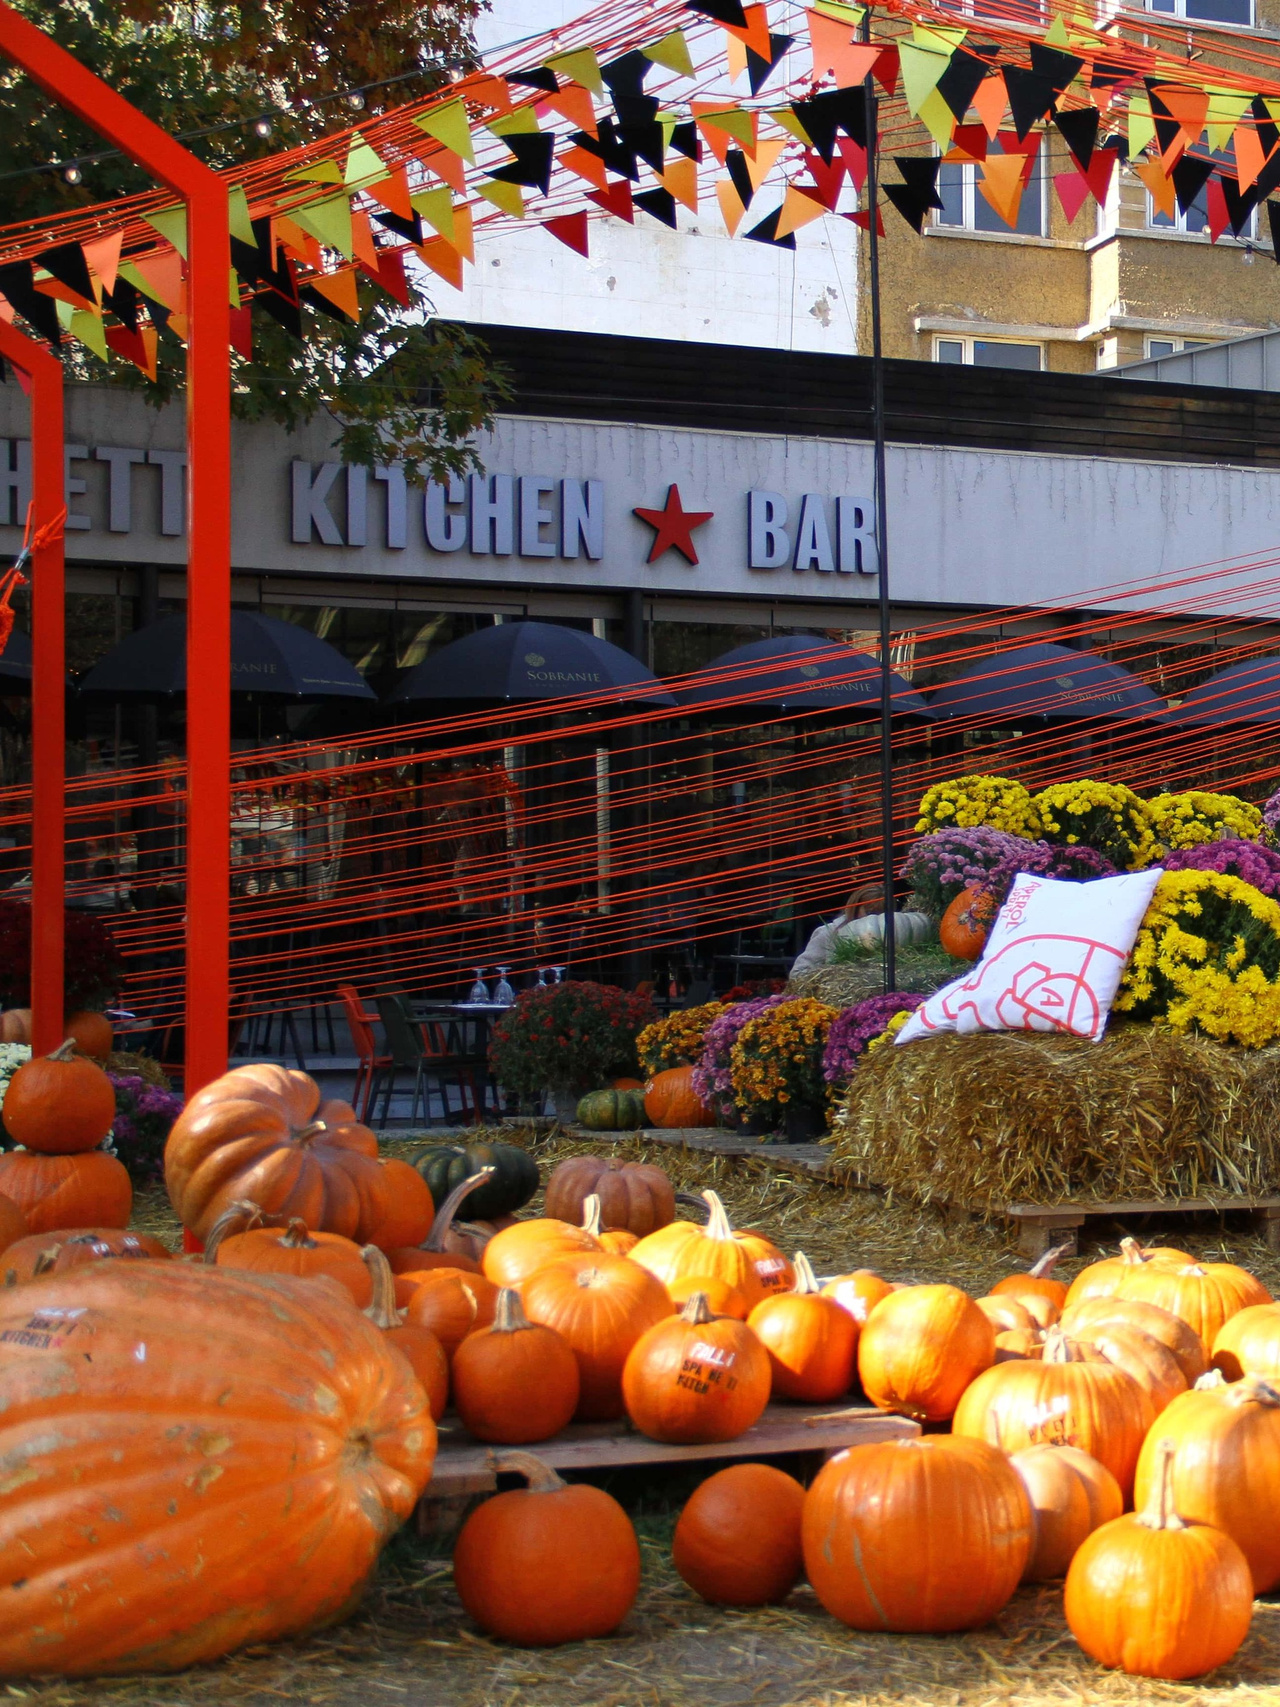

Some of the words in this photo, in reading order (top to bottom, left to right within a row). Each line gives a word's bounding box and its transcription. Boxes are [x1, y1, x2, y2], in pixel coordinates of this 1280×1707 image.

[0, 439, 188, 535] HETT
[291, 459, 604, 560] KITCHEN
[748, 490, 879, 574] BAR
[230, 662, 278, 674] RANIE
[527, 670, 601, 683] SOBRANIE
